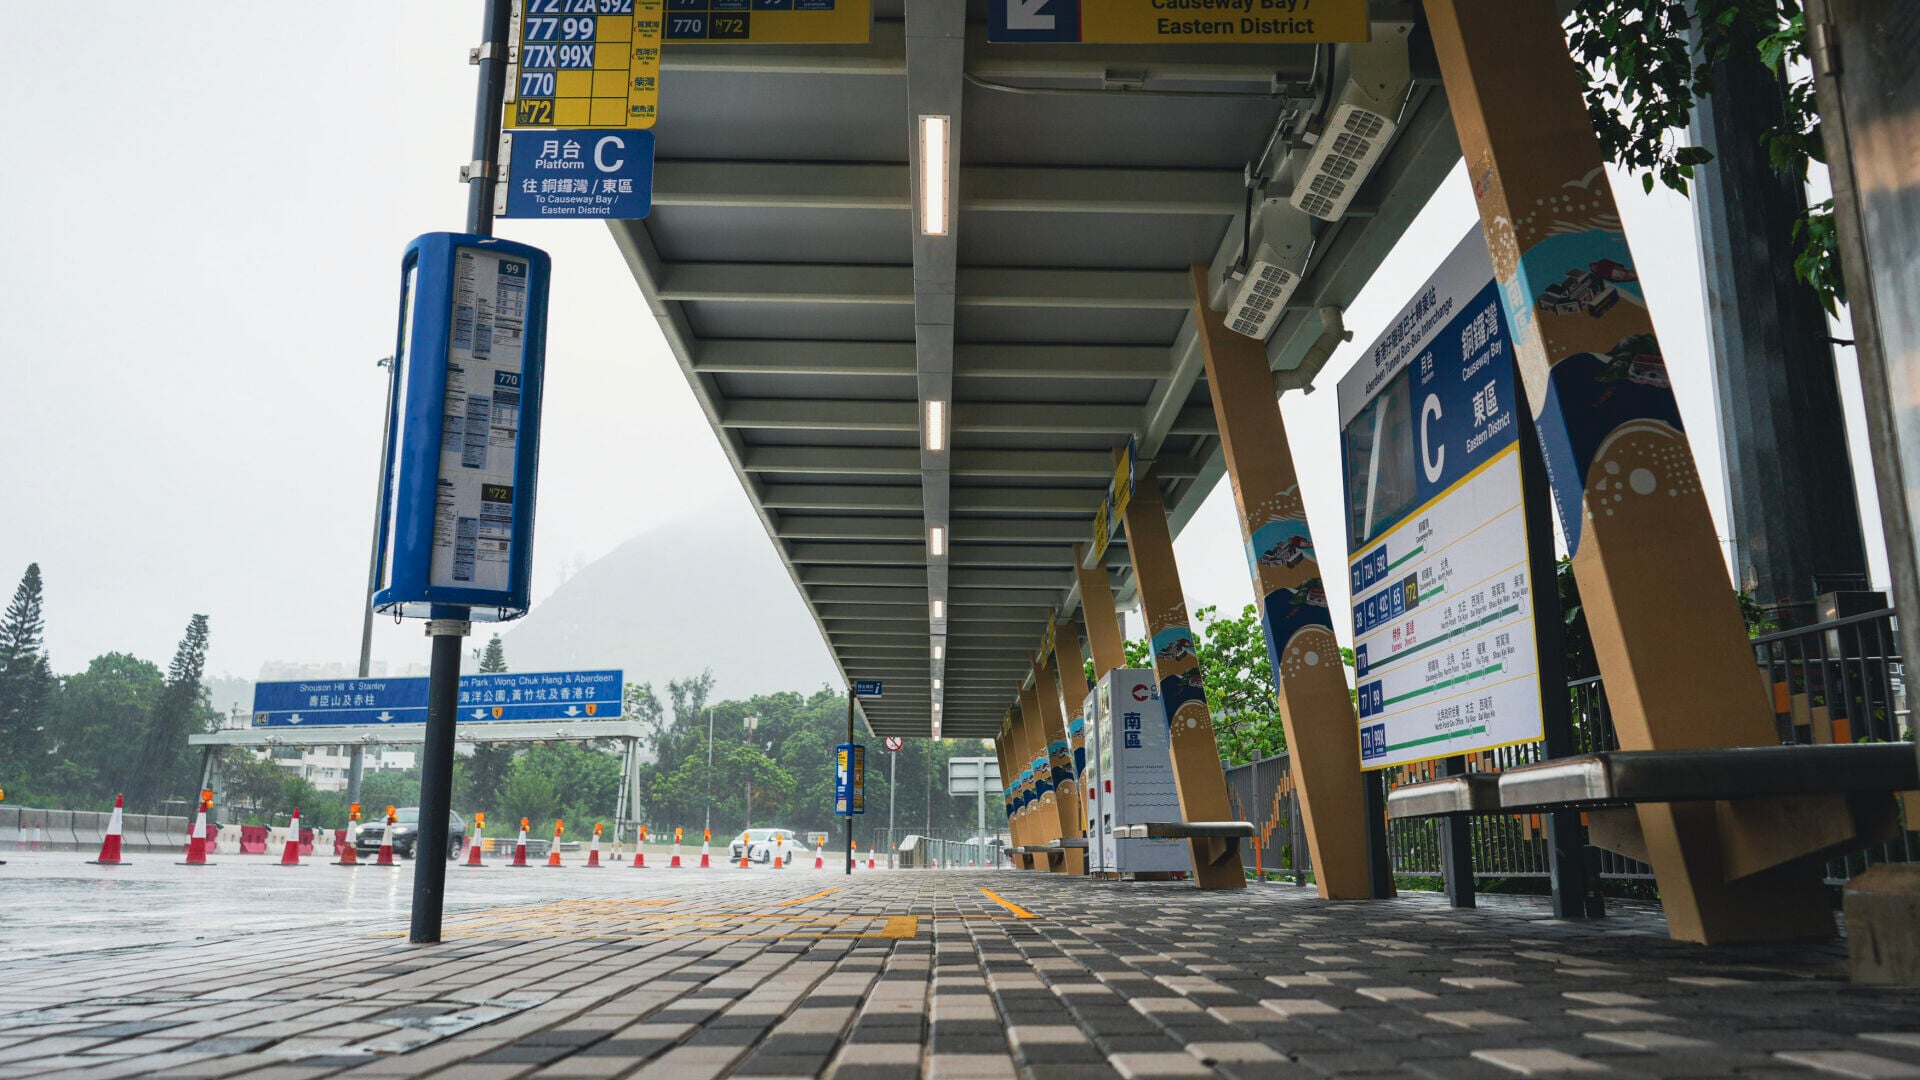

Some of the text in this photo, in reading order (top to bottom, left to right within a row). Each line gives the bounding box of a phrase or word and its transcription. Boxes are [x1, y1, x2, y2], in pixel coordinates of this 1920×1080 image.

[526, 18, 594, 40] 77 99
[673, 19, 701, 33] 770
[1157, 18, 1314, 34] Eastern District
[523, 45, 594, 68] 77X 99X
[522, 73, 553, 96] 770
[540, 139, 581, 159] 月台
[593, 135, 625, 173] C
[535, 159, 585, 169] Platform
[522, 179, 537, 193] 往
[541, 178, 588, 194] 銅鑼灣
[602, 178, 633, 194] 東區
[535, 195, 545, 203] To
[548, 195, 593, 205] Causeway
[597, 195, 613, 205] Bay
[541, 206, 611, 215] Eastern District
[506, 263, 519, 274] 99
[1461, 301, 1499, 362] 銅鑼灣
[1365, 297, 1453, 396] Aberdeen Tunnel Bus-Bus Interchange
[1421, 351, 1433, 376] 月台
[1462, 339, 1502, 382] Causeway Bay
[499, 373, 518, 385] 770
[1472, 378, 1499, 428] 東區
[1420, 392, 1445, 484] C
[1466, 411, 1511, 454] Eastern District
[1353, 570, 1360, 588] 72
[1393, 587, 1401, 606] 65
[300, 682, 386, 692] Shouson Hill & Stanley
[494, 677, 516, 687] Wong
[519, 676, 539, 685] Chuk
[542, 675, 563, 685] Hang
[565, 674, 572, 683] &
[574, 674, 613, 683] Aberdeen
[1361, 689, 1380, 711] 77 99
[1124, 712, 1142, 749] 南區
[1362, 731, 1372, 749] 77X
